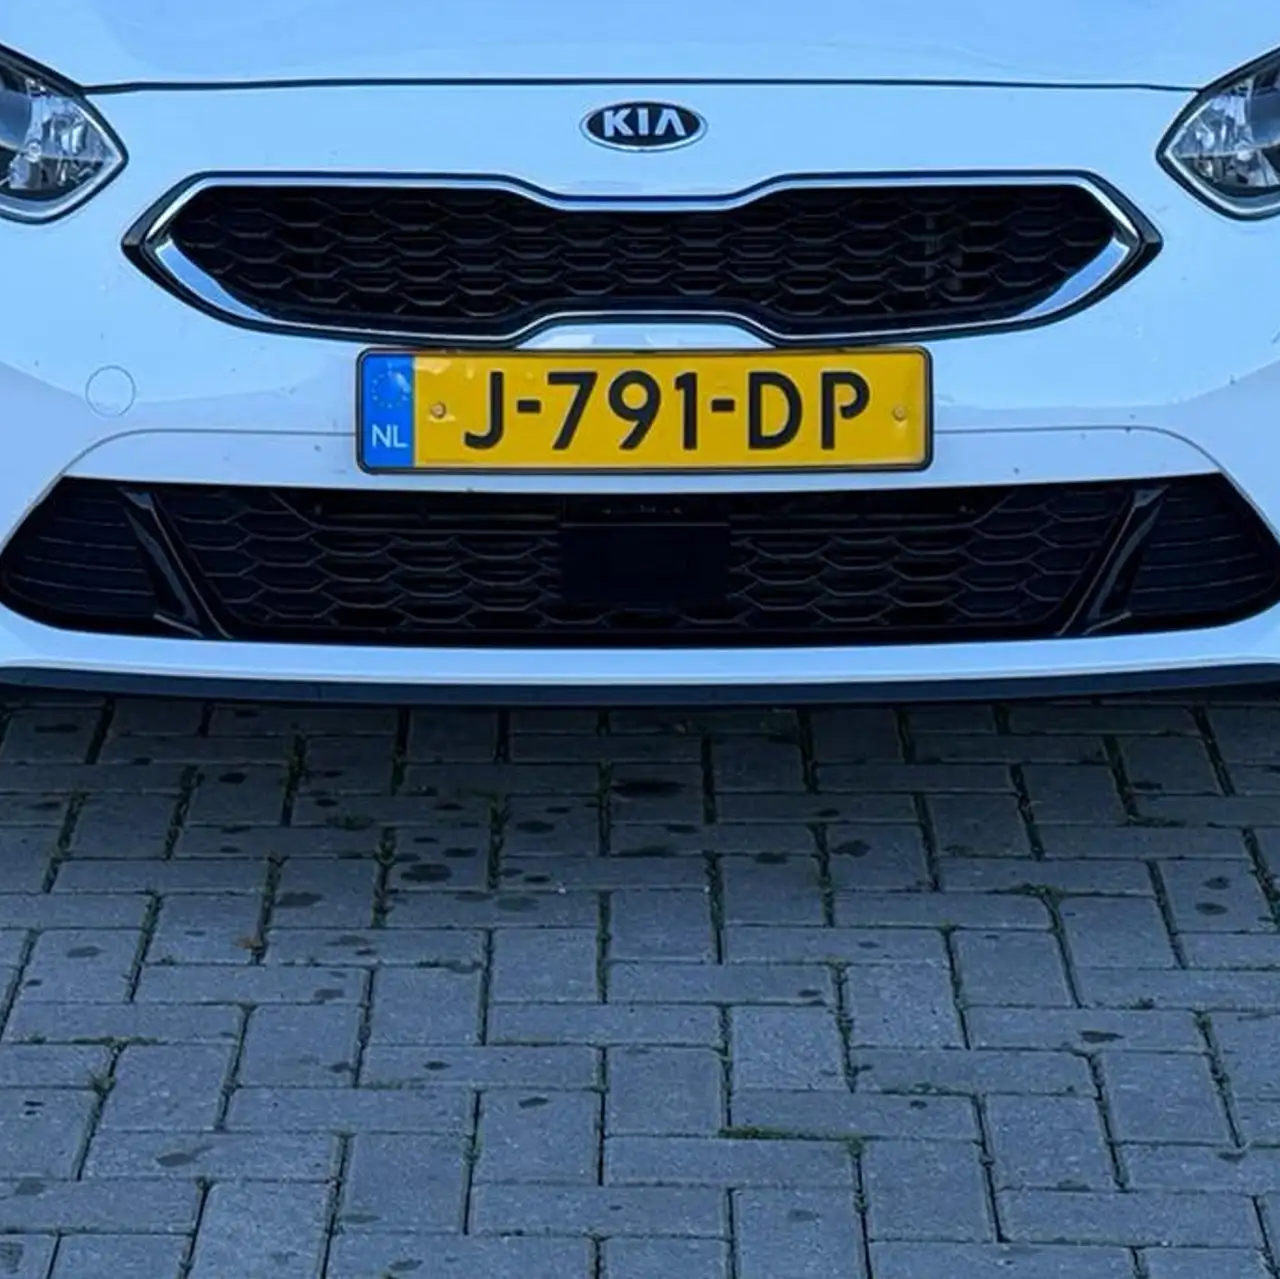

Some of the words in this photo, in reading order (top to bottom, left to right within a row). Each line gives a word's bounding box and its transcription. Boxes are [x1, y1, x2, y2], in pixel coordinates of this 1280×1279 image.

[603, 107, 687, 137] KIA
[464, 371, 871, 451] J-791-DP
[371, 423, 409, 448] NL
